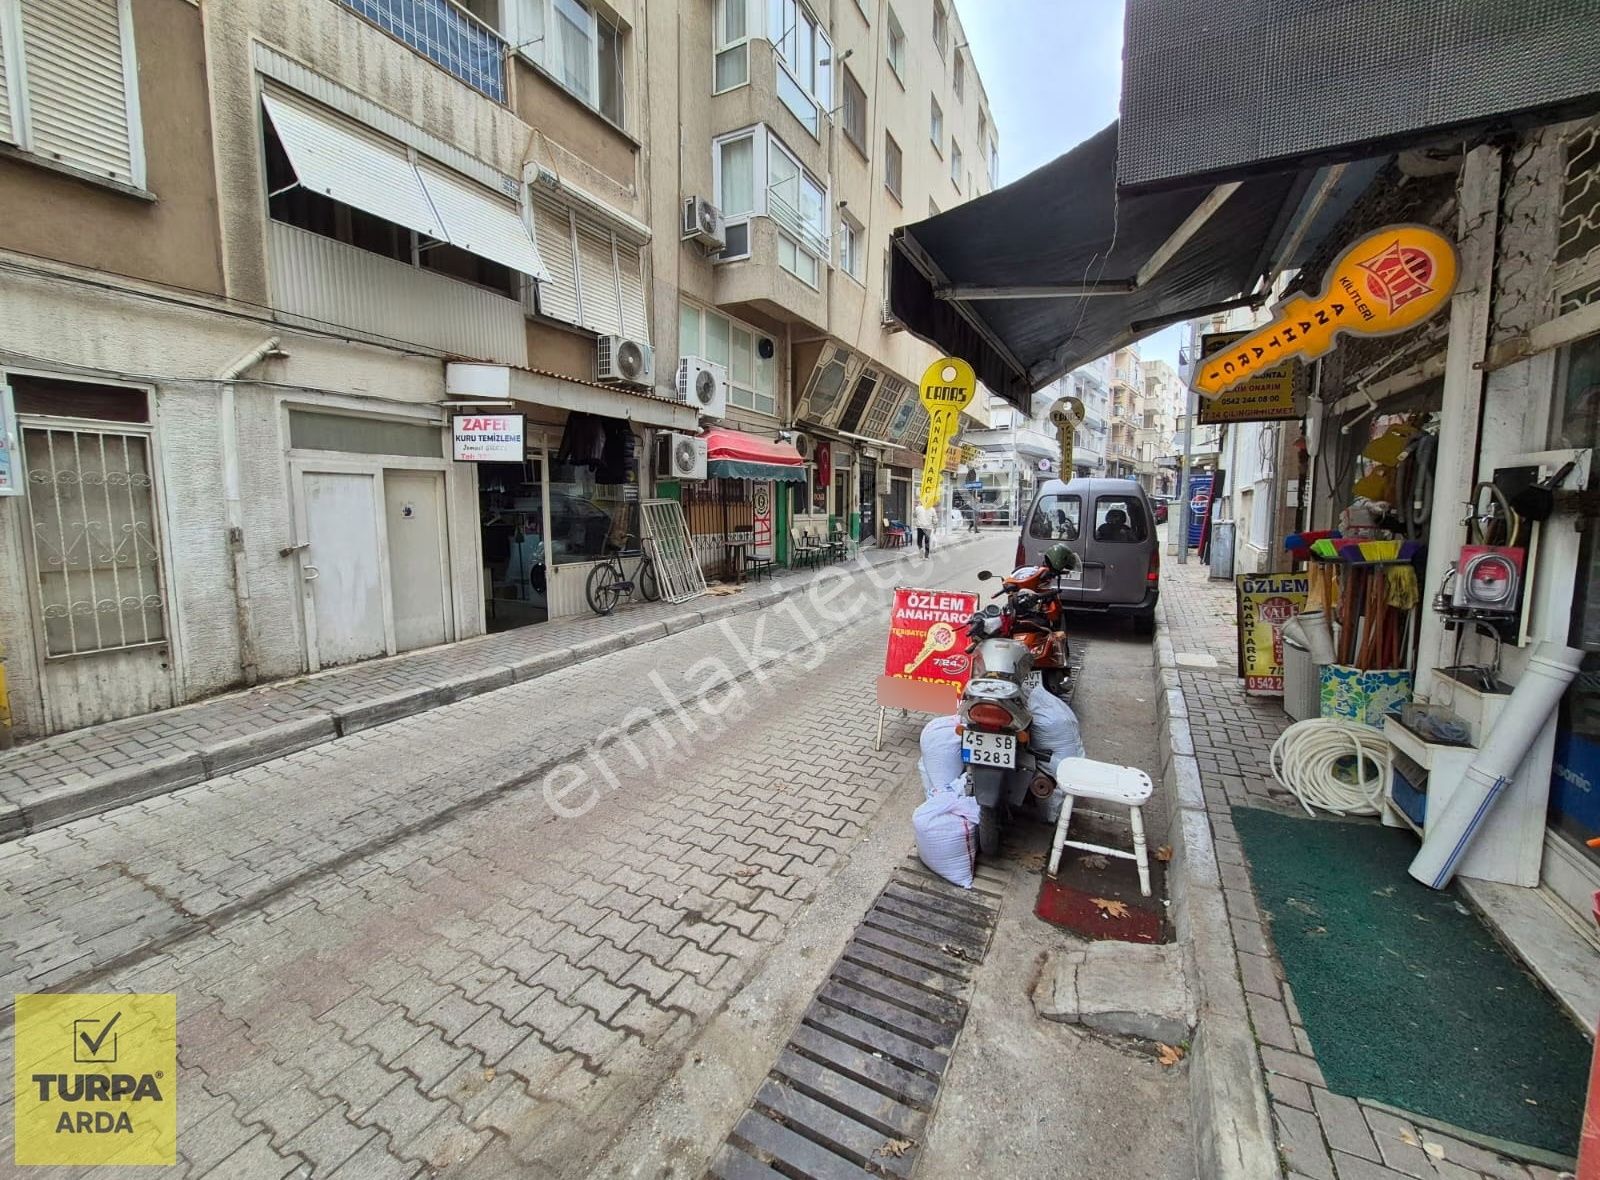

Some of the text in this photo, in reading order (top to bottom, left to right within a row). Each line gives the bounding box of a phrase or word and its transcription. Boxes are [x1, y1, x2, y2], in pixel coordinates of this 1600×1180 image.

[1361, 241, 1432, 312] KALE
[1341, 276, 1375, 321] KİLİTLERİ
[1210, 303, 1345, 379] ANAHTARCI
[456, 434, 477, 442] KURU
[907, 593, 965, 611] ÖZLEM
[1244, 596, 1257, 670] ANAHTARCI
[1257, 677, 1274, 688] 542
[966, 731, 1012, 749] 45 SB
[973, 749, 1010, 764] 5283
